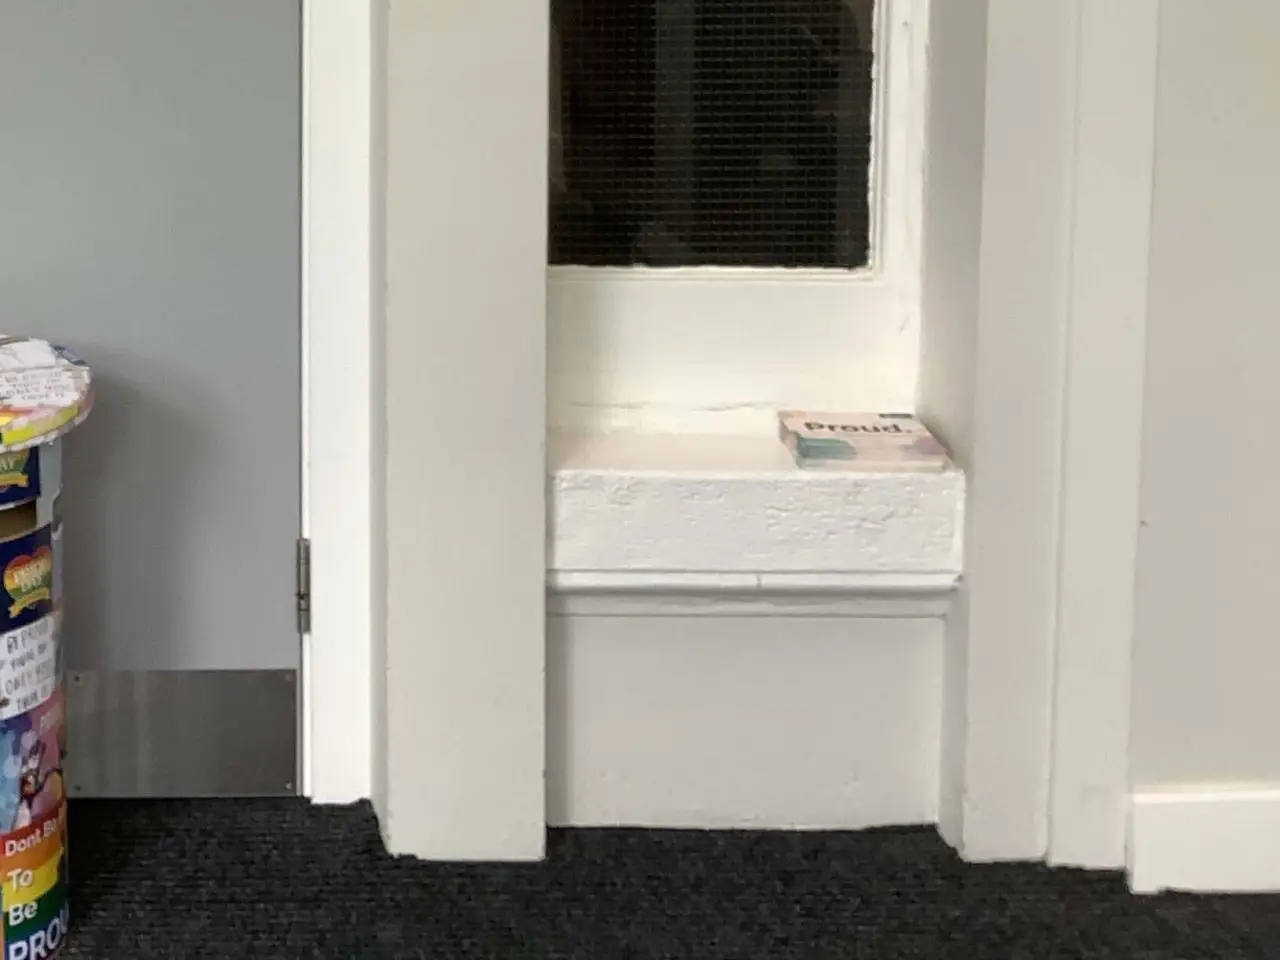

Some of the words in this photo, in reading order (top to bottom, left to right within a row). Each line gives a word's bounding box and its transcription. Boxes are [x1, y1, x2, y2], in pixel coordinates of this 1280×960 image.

[4, 828, 42, 857] Dont
[7, 868, 34, 890] To
[8, 900, 38, 926] Be
